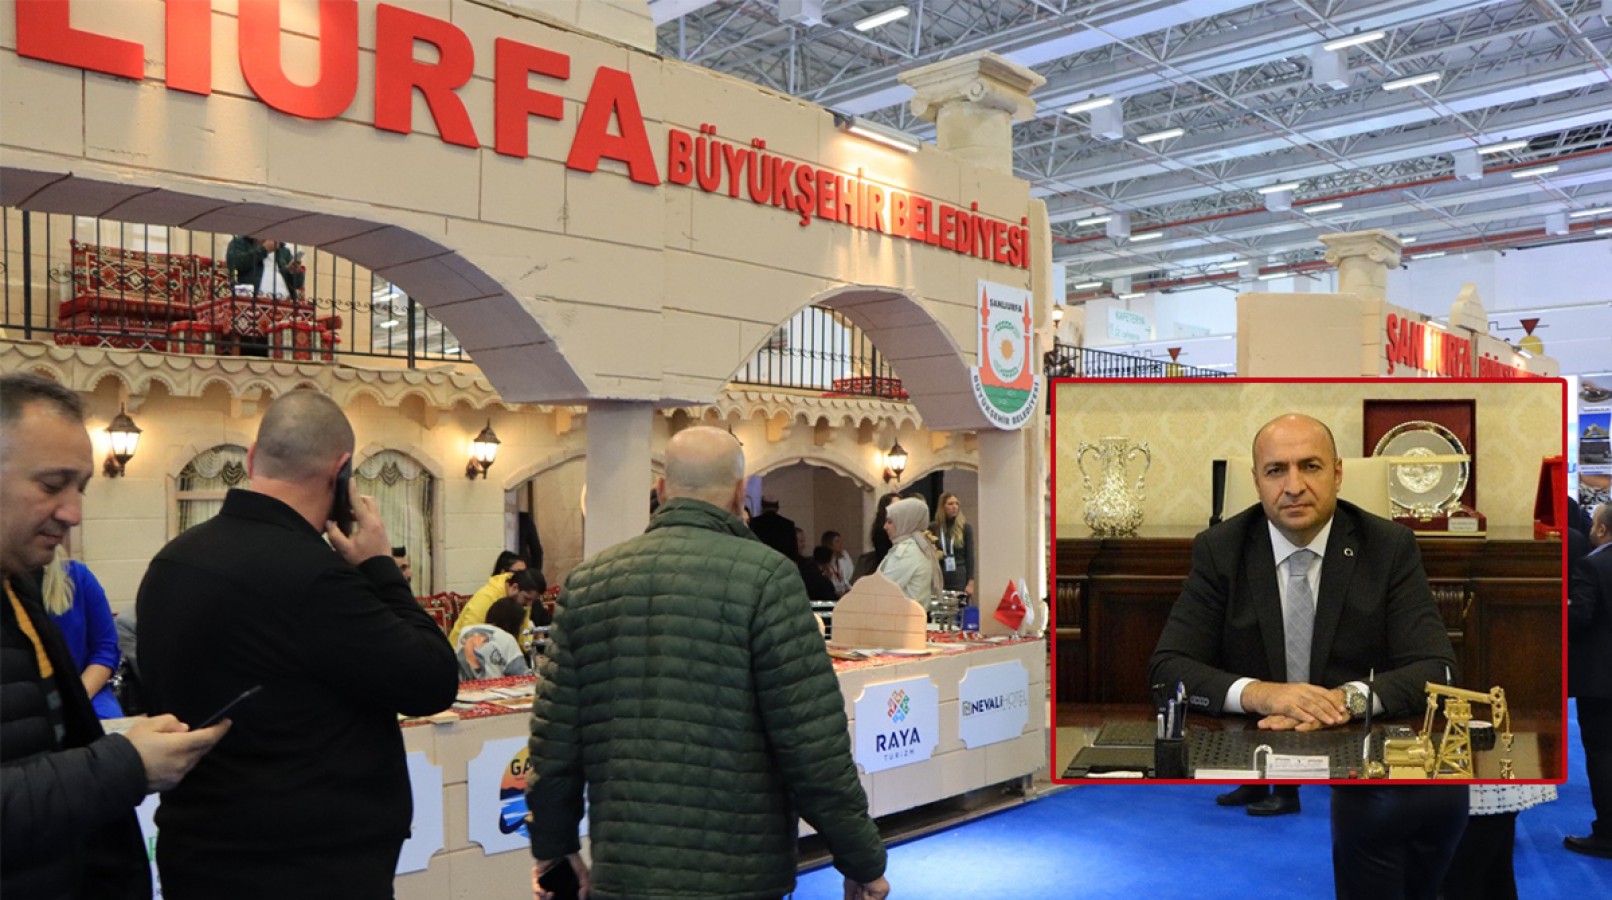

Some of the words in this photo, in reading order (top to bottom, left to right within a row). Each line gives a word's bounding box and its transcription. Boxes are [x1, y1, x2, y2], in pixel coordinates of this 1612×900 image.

[669, 123, 886, 233] BÜYÜKŞEHİR
[891, 200, 1030, 269] BELEDİYESİ
[876, 727, 921, 753] RAYA
